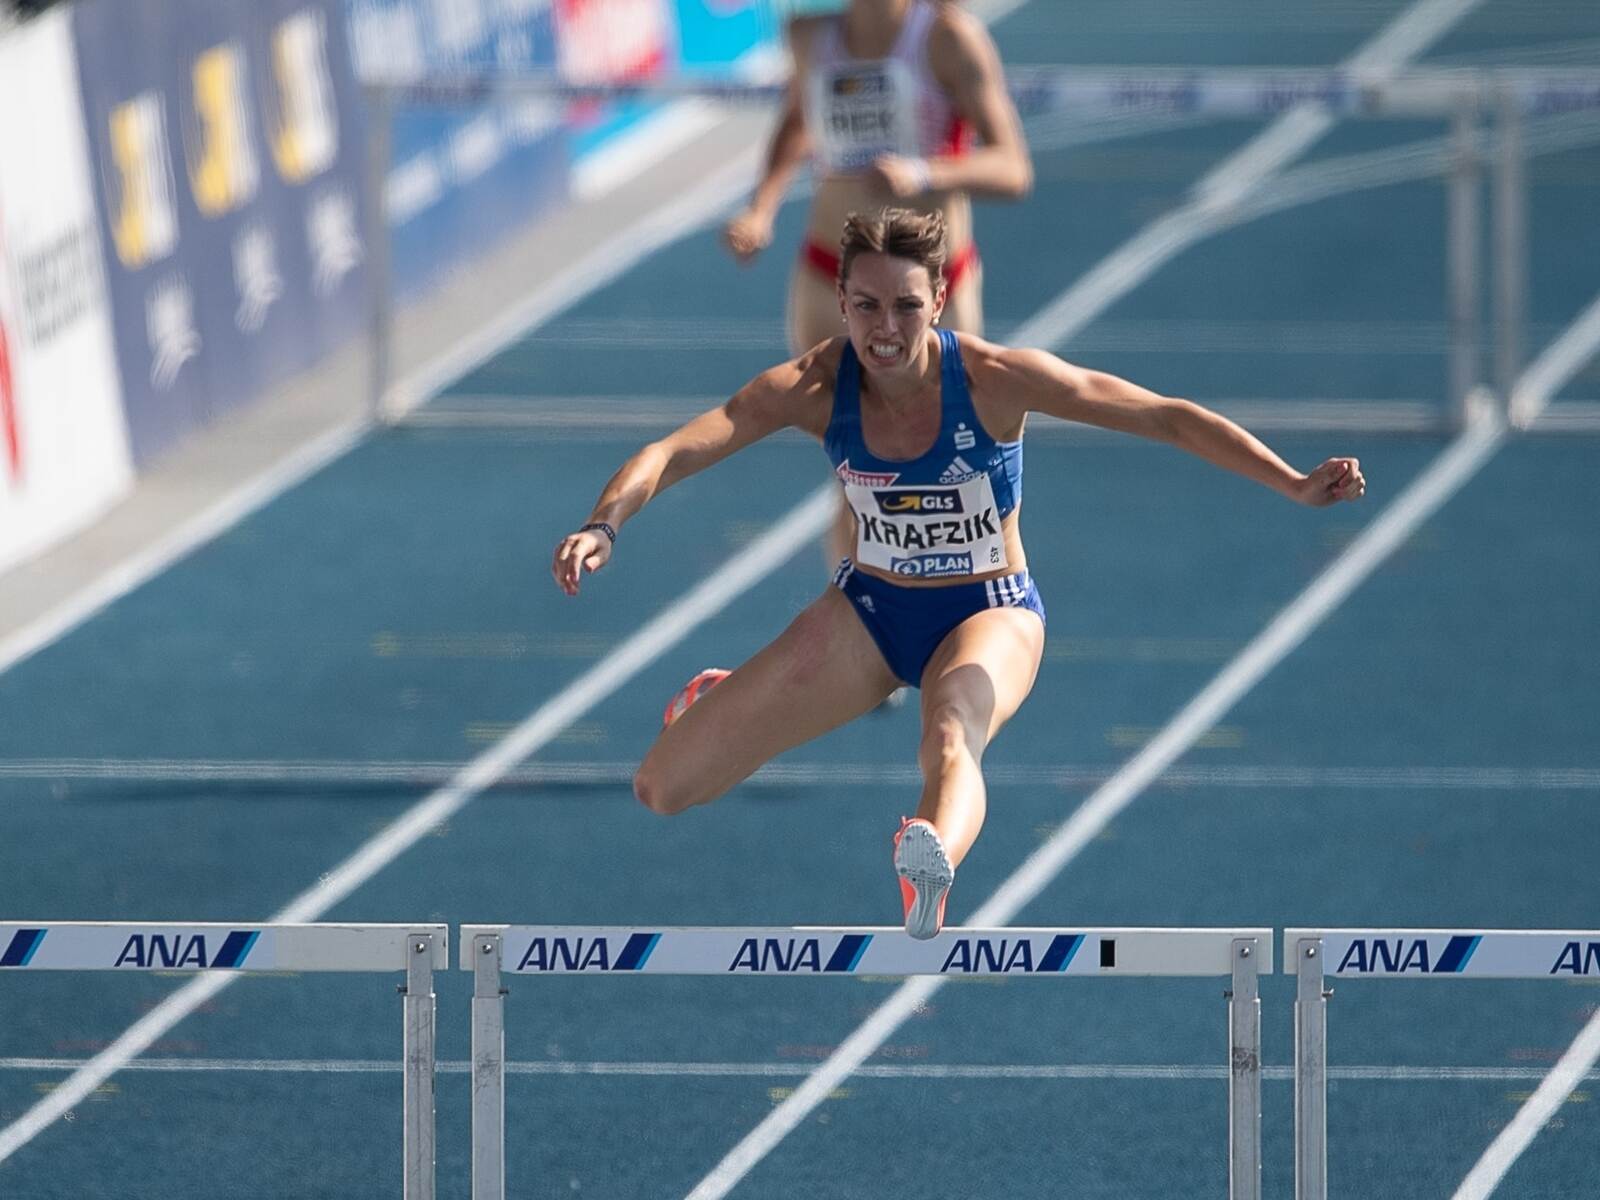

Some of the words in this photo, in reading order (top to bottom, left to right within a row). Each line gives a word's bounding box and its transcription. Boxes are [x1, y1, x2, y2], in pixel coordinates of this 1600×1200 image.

[922, 495, 954, 510] GLS
[861, 508, 997, 549] KRAFZIK
[924, 557, 970, 573] PLAN
[990, 547, 1000, 563] 453
[114, 934, 207, 967] ANA
[517, 937, 609, 971] ANA
[728, 938, 821, 972] ANA
[940, 939, 1033, 972] ANA
[1337, 939, 1430, 973] ANA
